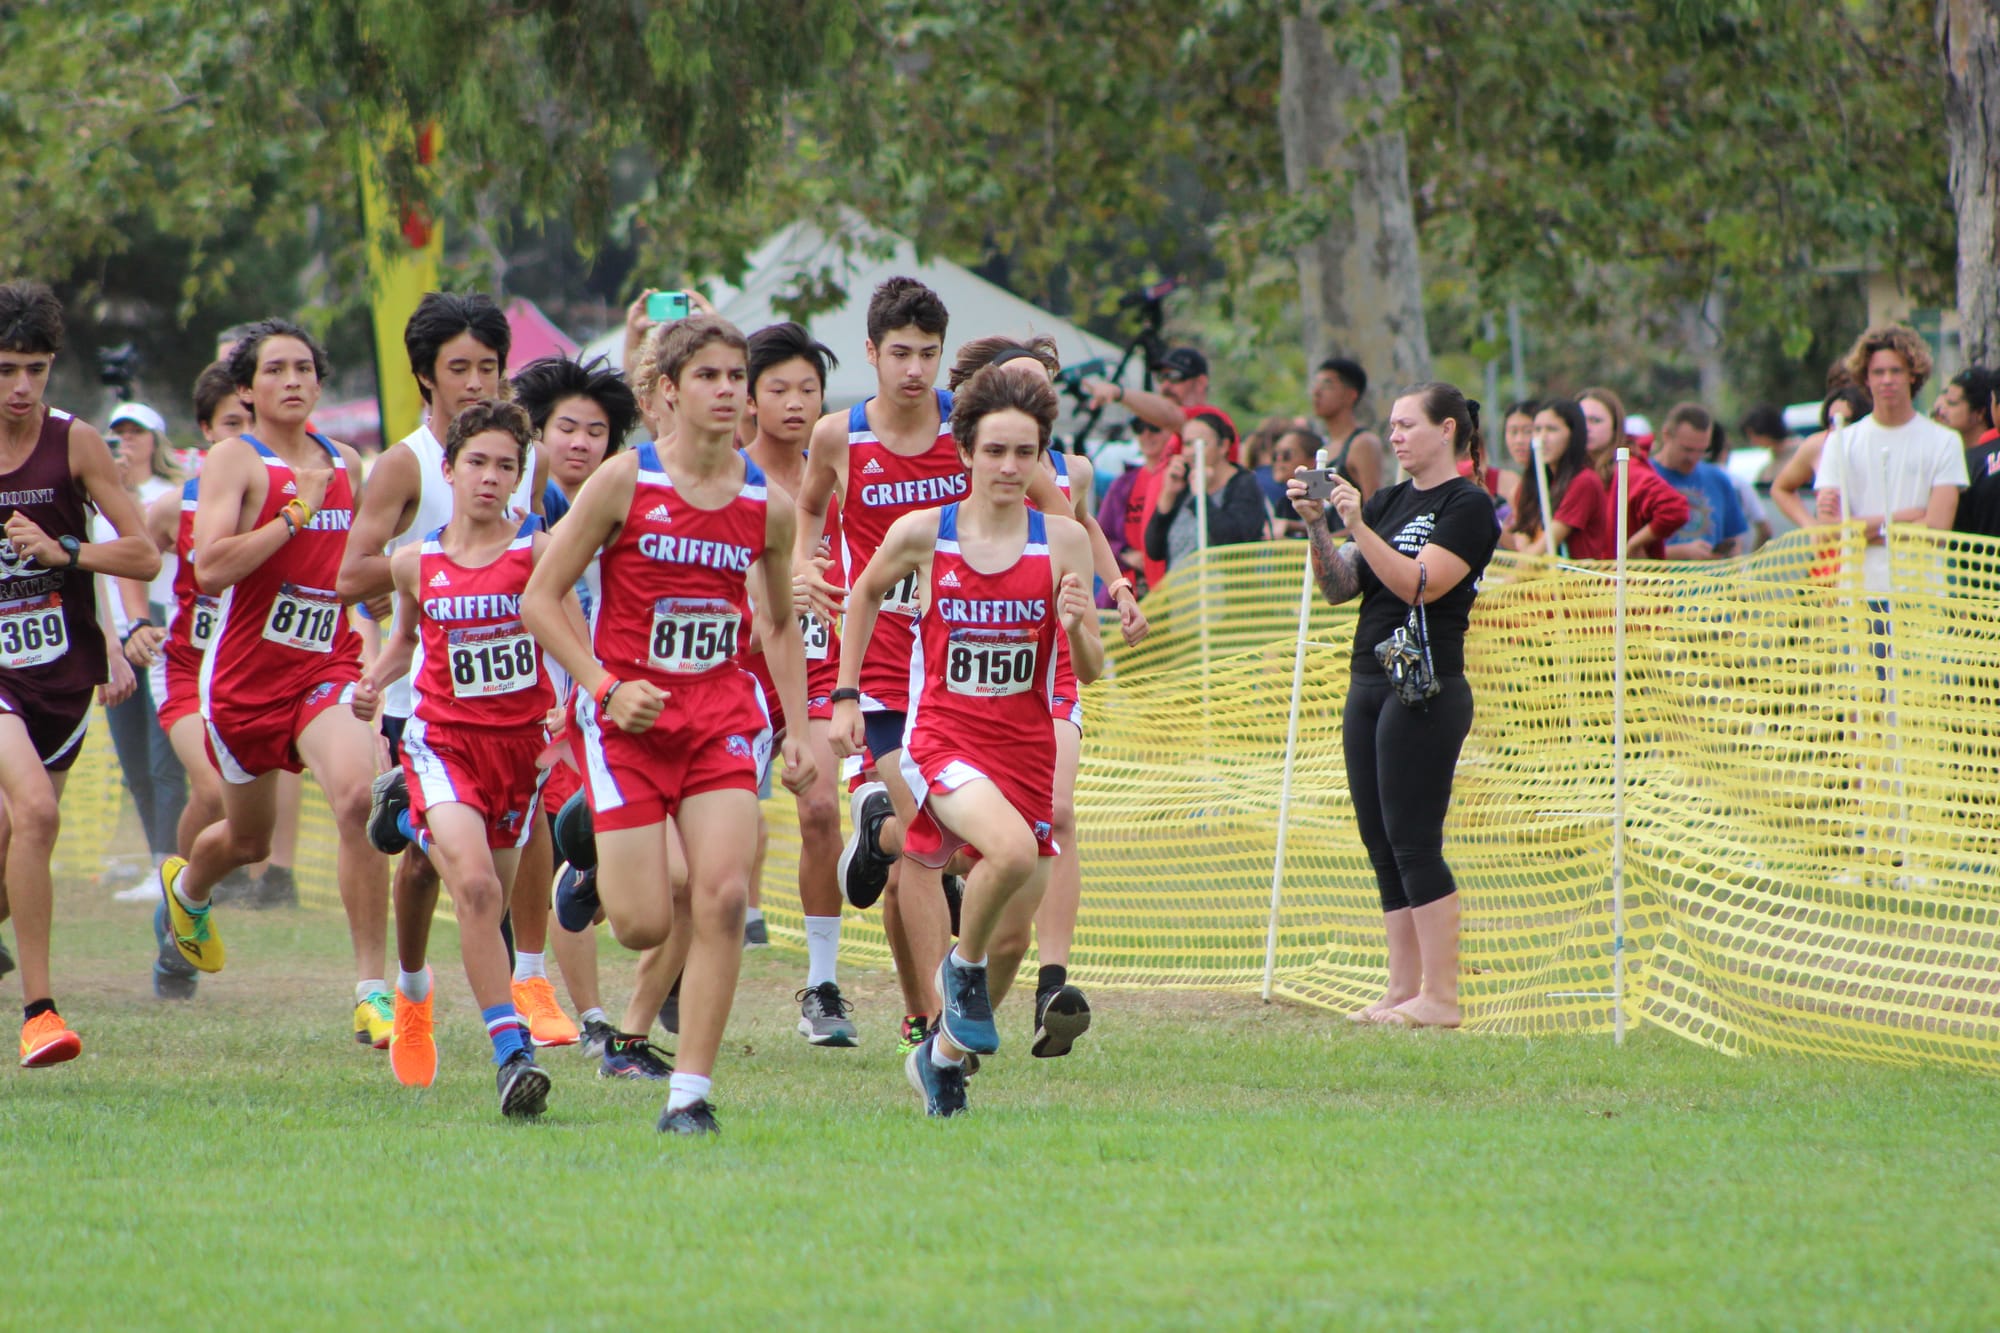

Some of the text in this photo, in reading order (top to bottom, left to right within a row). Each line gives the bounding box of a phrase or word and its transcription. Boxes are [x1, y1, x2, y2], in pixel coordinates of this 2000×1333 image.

[862, 473, 967, 506] GRIFFINS
[645, 513, 672, 523] adidas
[639, 533, 752, 572] GRIFFINS
[1398, 543, 1422, 552] RIGH
[938, 580, 961, 588] adidas
[272, 600, 335, 642] 8118
[423, 594, 521, 621] GRIFFIN
[937, 598, 1046, 623] GRIFFINS
[653, 619, 736, 661] 8154
[452, 639, 534, 685] 8158
[950, 647, 1034, 685] 8150
[483, 681, 515, 693] MileSplit
[975, 686, 1008, 695] MileSplit
